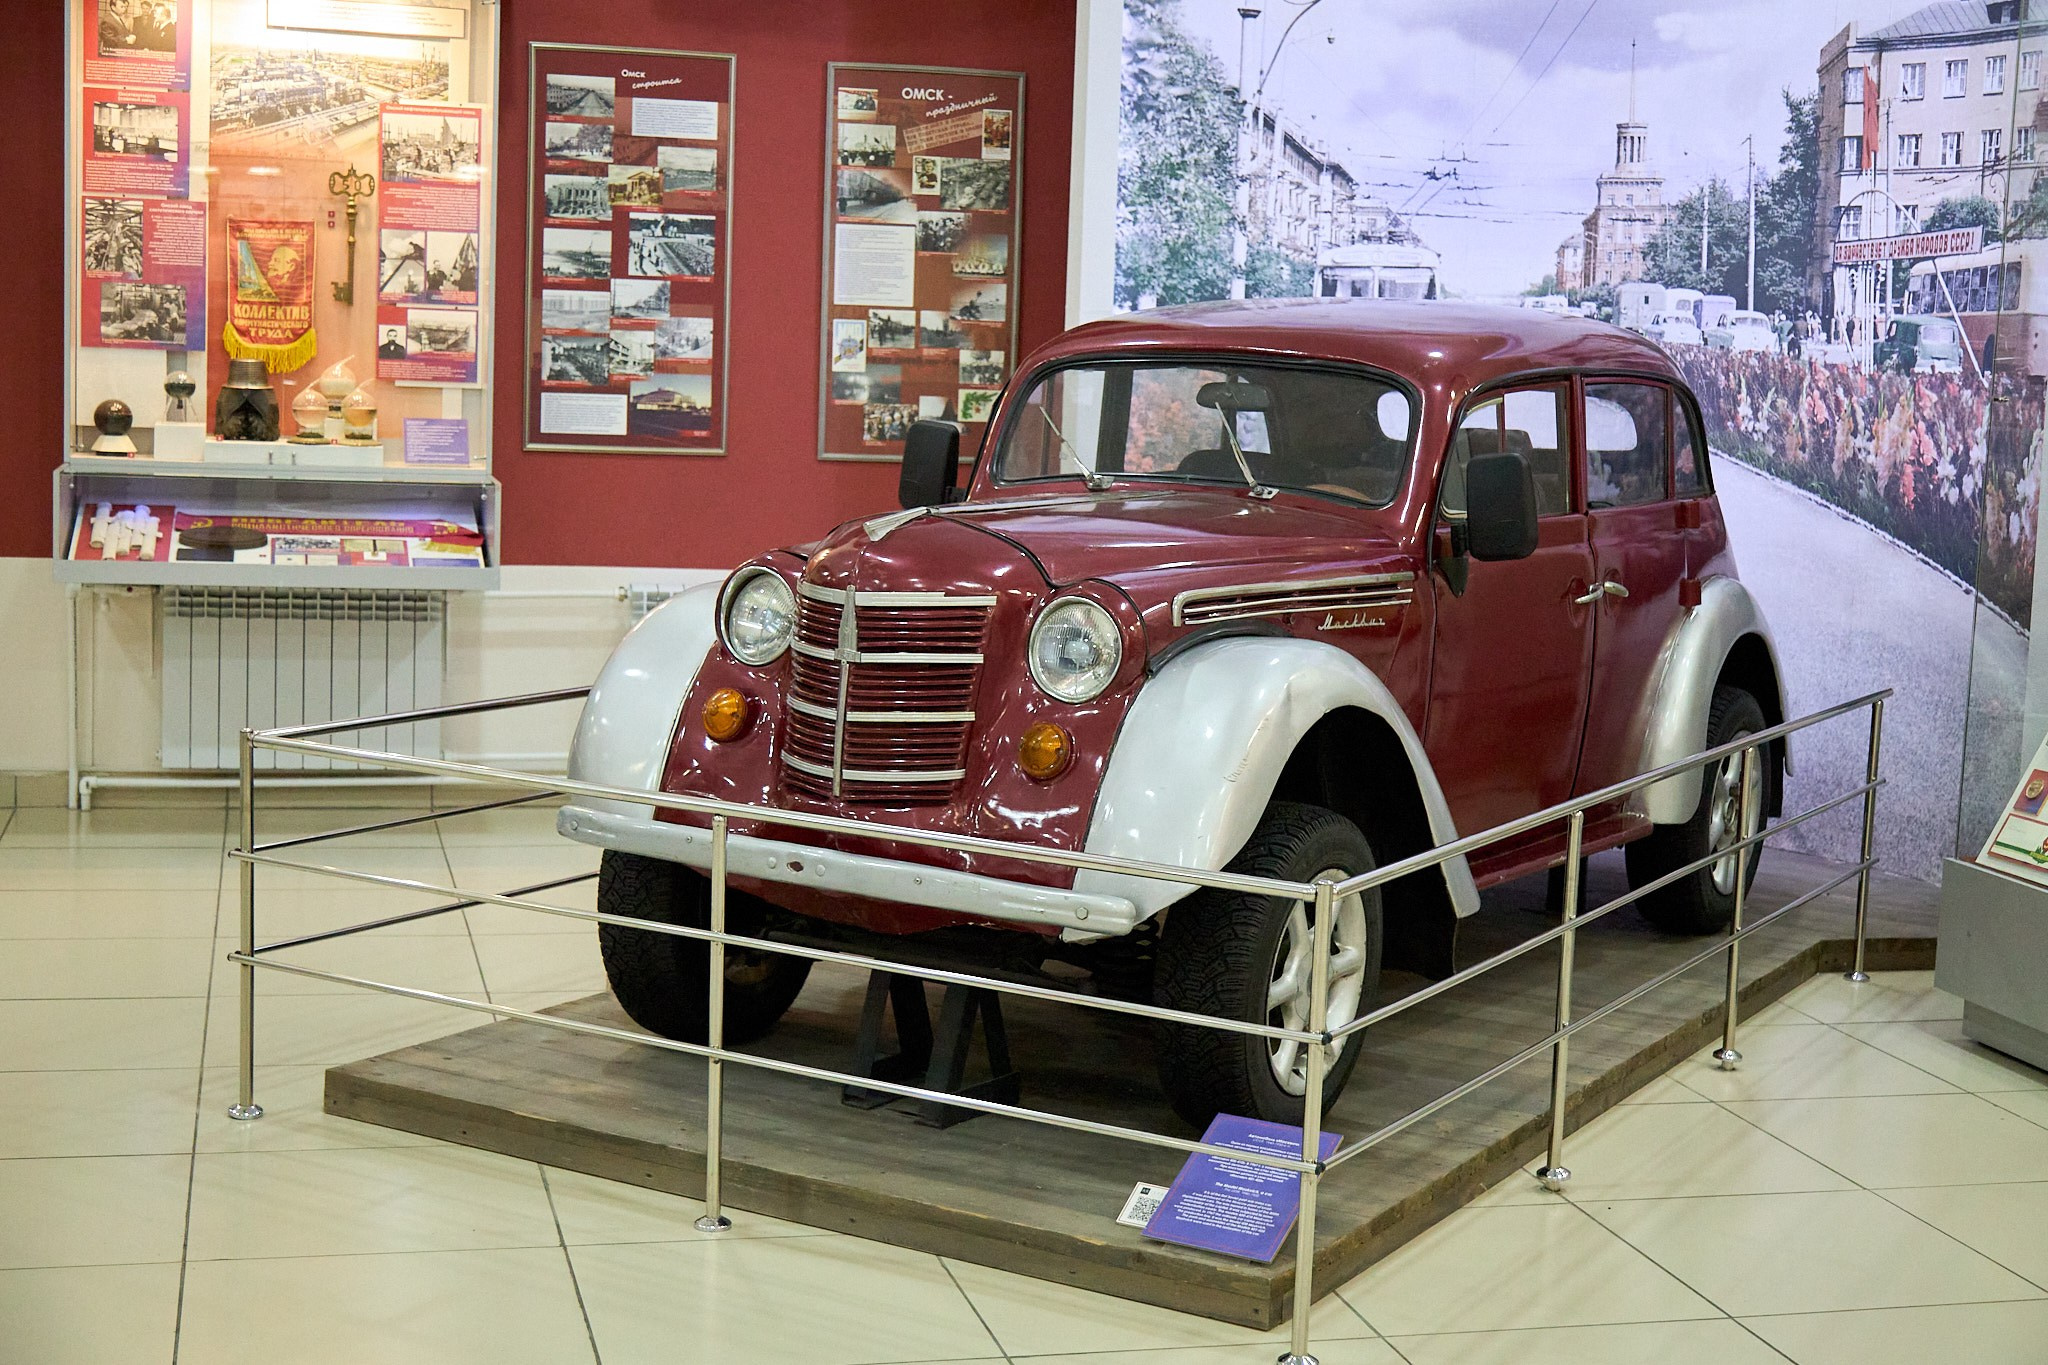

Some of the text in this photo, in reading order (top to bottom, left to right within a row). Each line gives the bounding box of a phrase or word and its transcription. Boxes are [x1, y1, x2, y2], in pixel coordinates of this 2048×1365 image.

[621, 69, 646, 79] Омск
[632, 77, 683, 90] строится
[901, 87, 944, 101] ОМСК
[925, 92, 998, 118] праздничный
[1843, 241, 1887, 261] ЗДРАВСТВУЕТ
[1889, 238, 1914, 258] ДРУЖБА
[1916, 233, 1948, 256] НАРОДОВ
[1950, 231, 1975, 253] СССР!
[234, 303, 310, 320] КОЛЛЕКТИВ
[249, 328, 294, 338] ТРУДА
